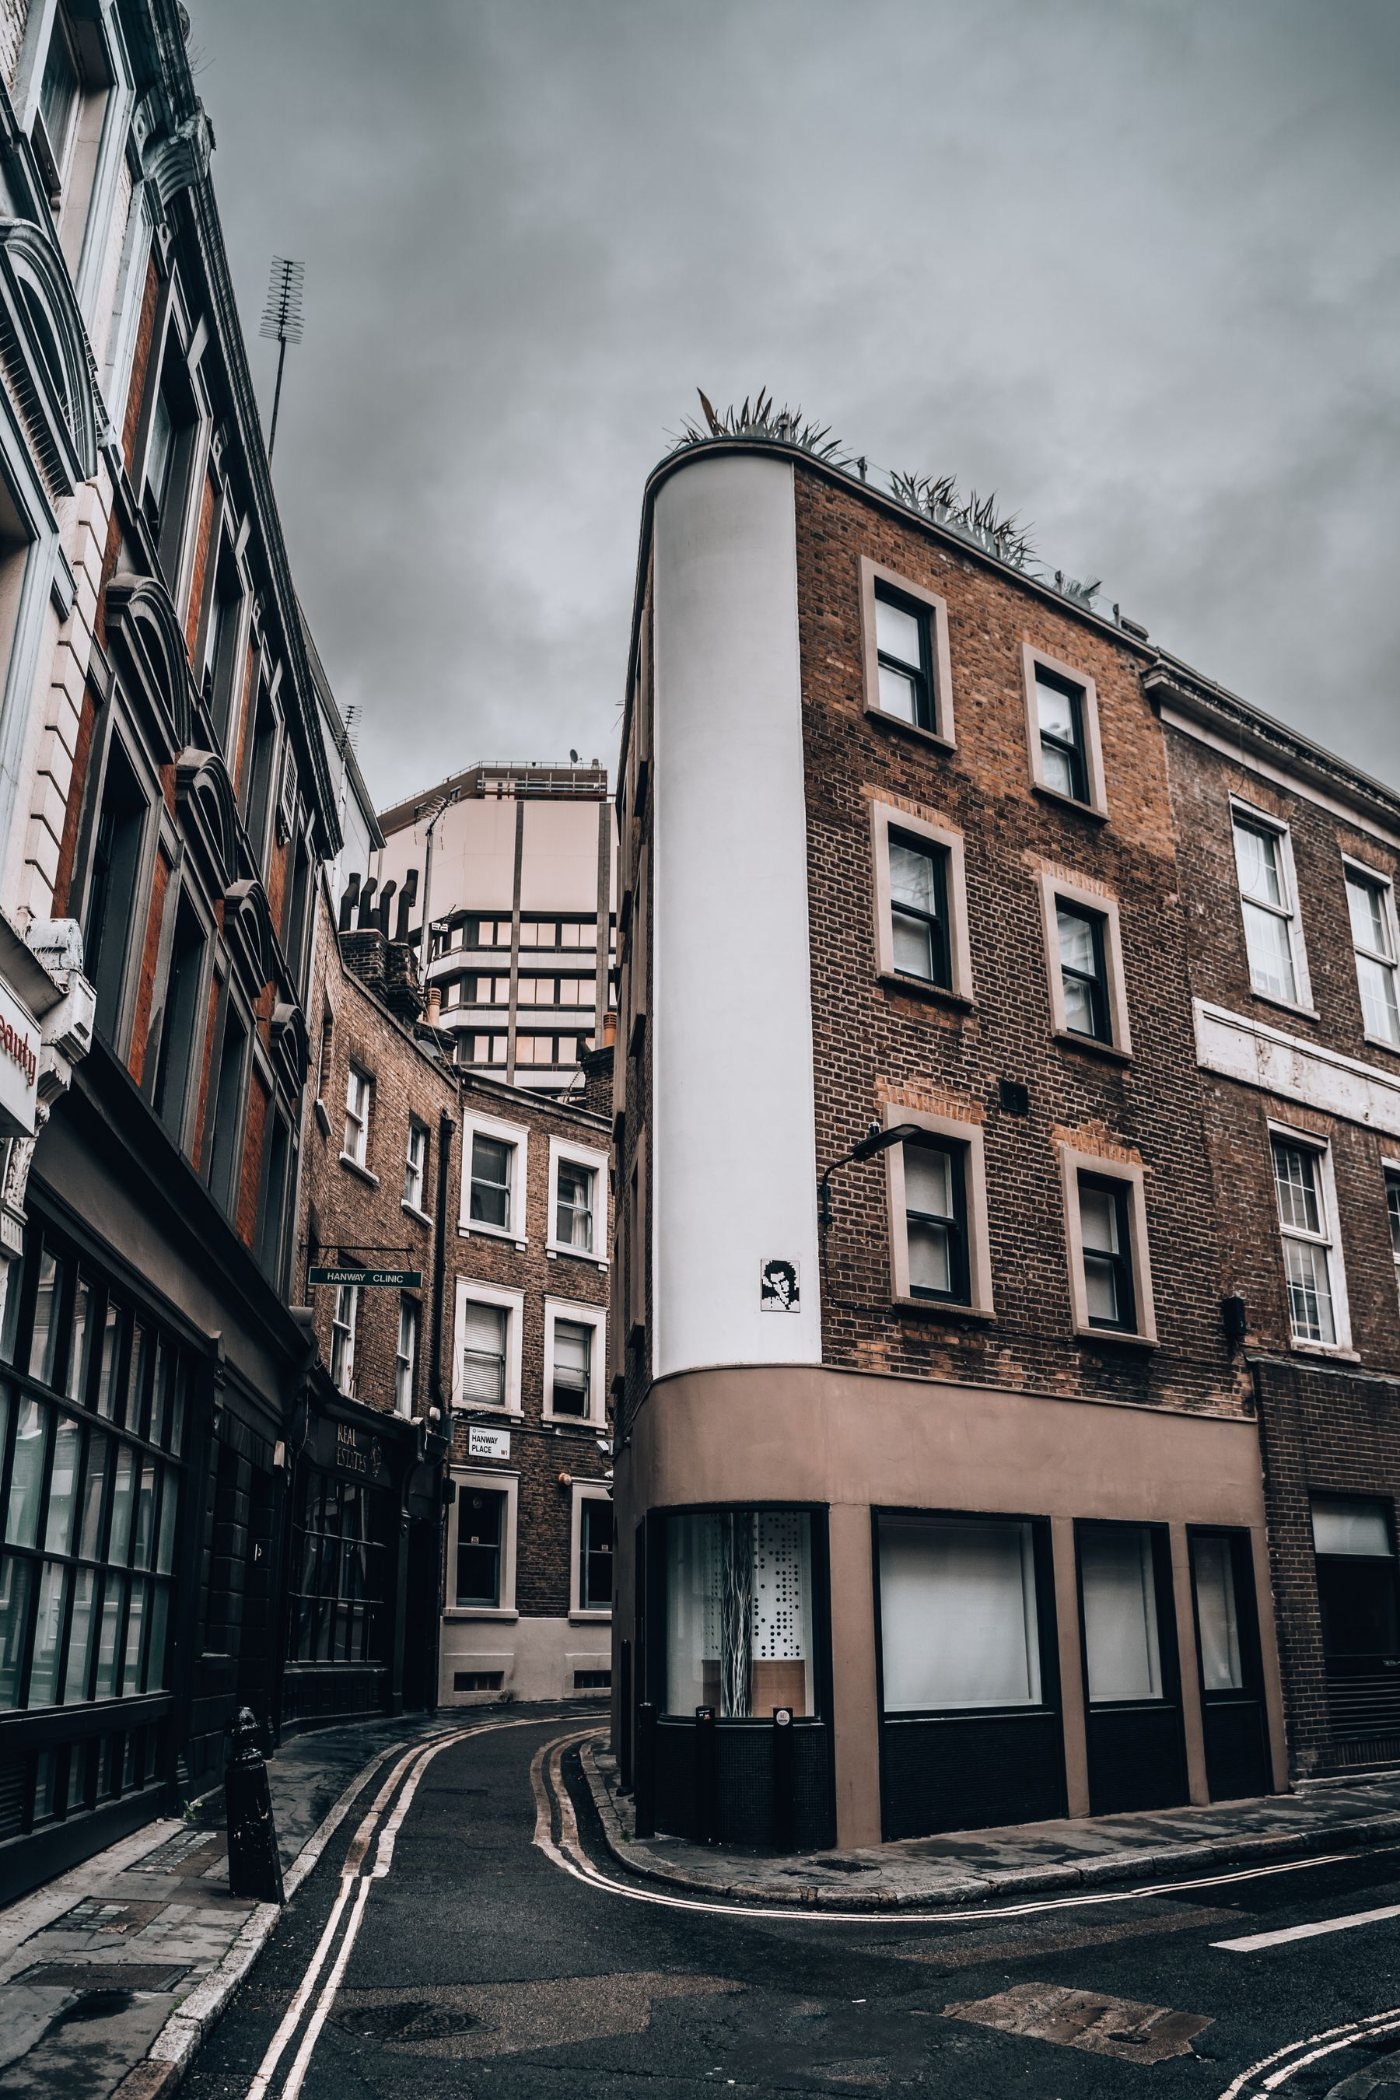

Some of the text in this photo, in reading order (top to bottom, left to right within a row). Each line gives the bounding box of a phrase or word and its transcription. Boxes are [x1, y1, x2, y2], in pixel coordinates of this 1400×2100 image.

[327, 1272, 404, 1283] HANWAY CLINIC
[337, 1423, 357, 1447] REAL
[471, 1434, 499, 1444] HANWAY
[471, 1444, 493, 1454] PLACE
[336, 1447, 367, 1473] ESTATES
